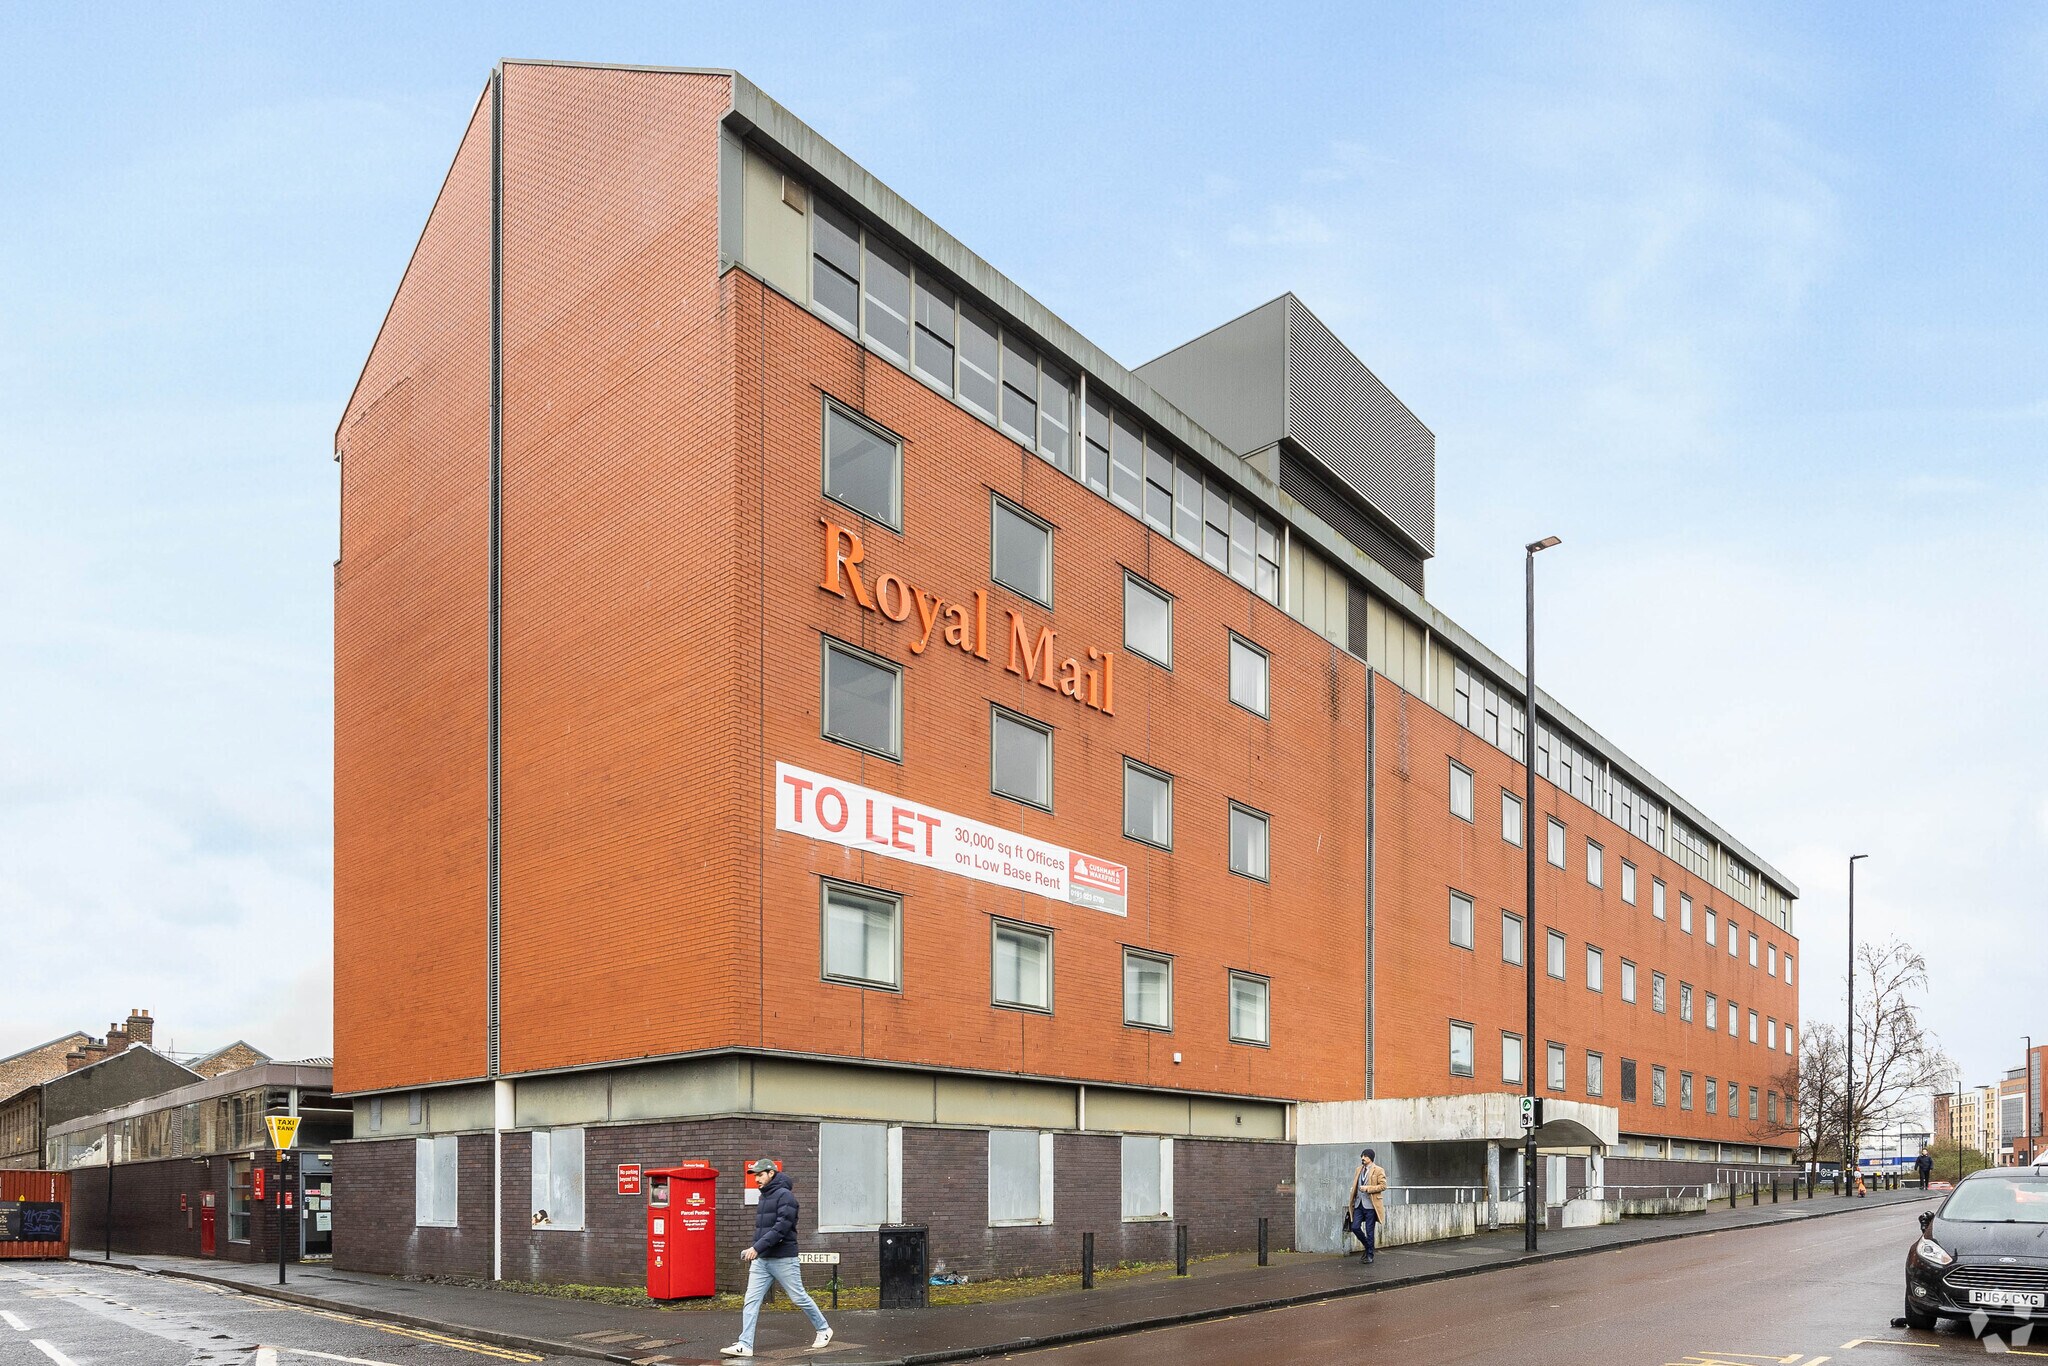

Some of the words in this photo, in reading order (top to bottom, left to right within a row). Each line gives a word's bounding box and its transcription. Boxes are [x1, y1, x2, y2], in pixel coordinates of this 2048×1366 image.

[819, 516, 990, 661] Royal
[1005, 608, 1115, 716] Mail
[783, 774, 848, 833] TO
[866, 798, 941, 857] LET
[955, 827, 994, 850] 30,000
[998, 842, 1011, 858] sq
[1015, 845, 1023, 859] ft
[1027, 849, 1065, 870] Offices
[955, 853, 970, 866] on
[975, 854, 999, 873] Low
[1004, 863, 1031, 882] Base
[1035, 872, 1060, 890] Rent
[1975, 1292, 2008, 1304] BU64
[2013, 1294, 2038, 1305] CYG
